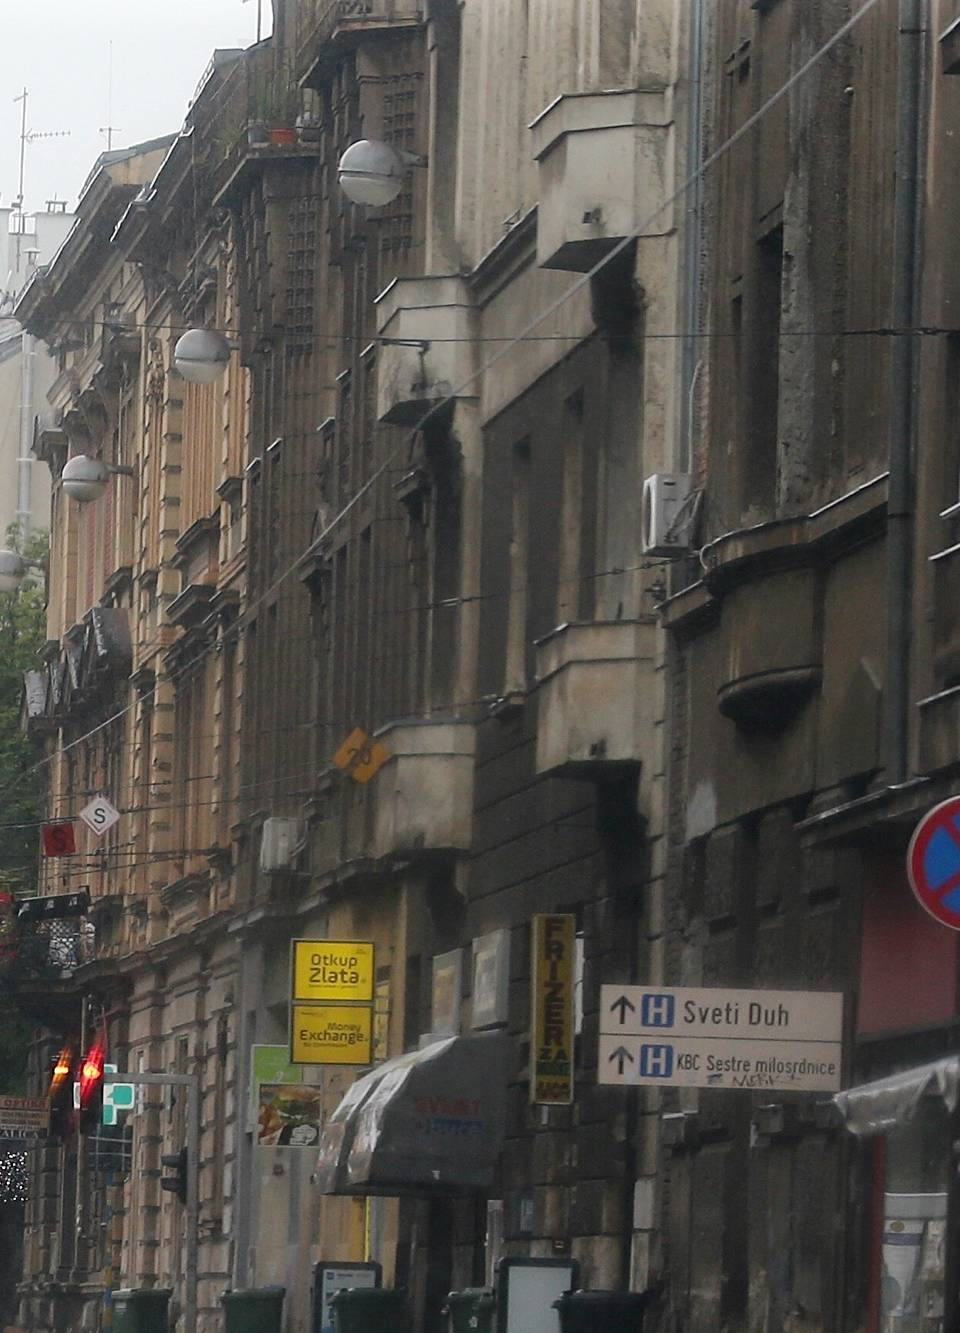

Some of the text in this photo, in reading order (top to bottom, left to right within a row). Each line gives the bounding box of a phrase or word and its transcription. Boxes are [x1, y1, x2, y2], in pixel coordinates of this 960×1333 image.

[94, 808, 106, 824] S
[311, 953, 358, 968] Otkup
[544, 918, 564, 1046] FRIZER
[683, 1000, 739, 1025] Sveti
[748, 1002, 789, 1026] Duh
[677, 1054, 700, 1071] KBC
[707, 1055, 751, 1073] Sestre
[756, 1057, 836, 1077] milosrdnice
